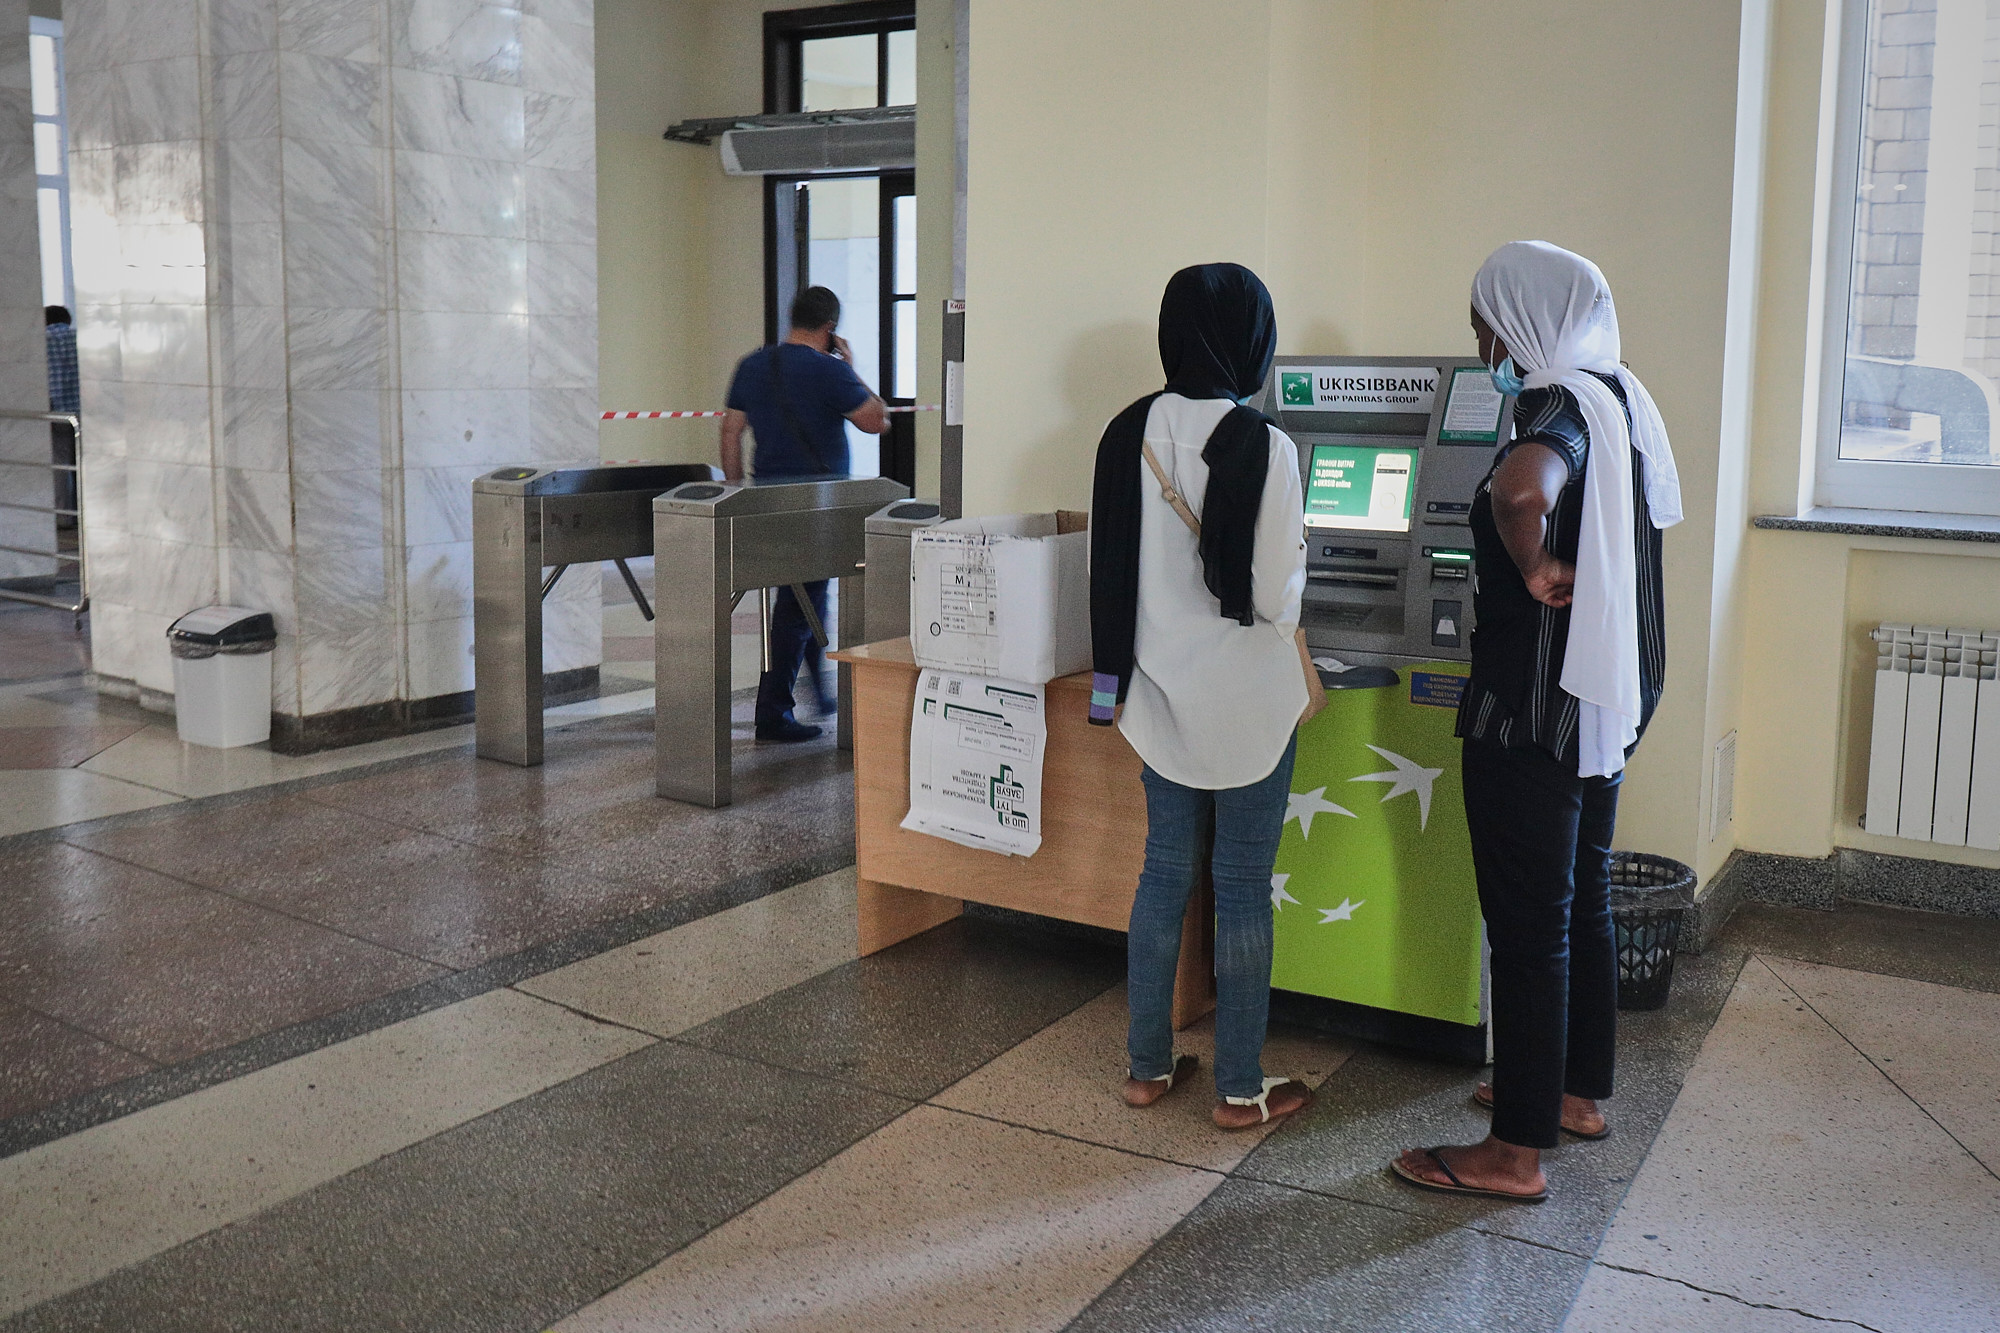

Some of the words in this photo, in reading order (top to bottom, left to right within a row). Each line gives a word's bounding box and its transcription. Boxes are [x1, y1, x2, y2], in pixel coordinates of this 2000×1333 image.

[1319, 377, 1435, 393] UKRSIBBANK
[1320, 394, 1340, 402] BNP
[1342, 394, 1383, 403] PARIBAS
[1385, 395, 1420, 404] GROUP
[955, 575, 964, 585] M
[1005, 773, 1011, 782] ?
[996, 785, 1022, 799] ЗАБУВ
[996, 799, 1010, 811] ТУТ
[1004, 815, 1010, 824] Я
[1012, 817, 1026, 829] ШО
